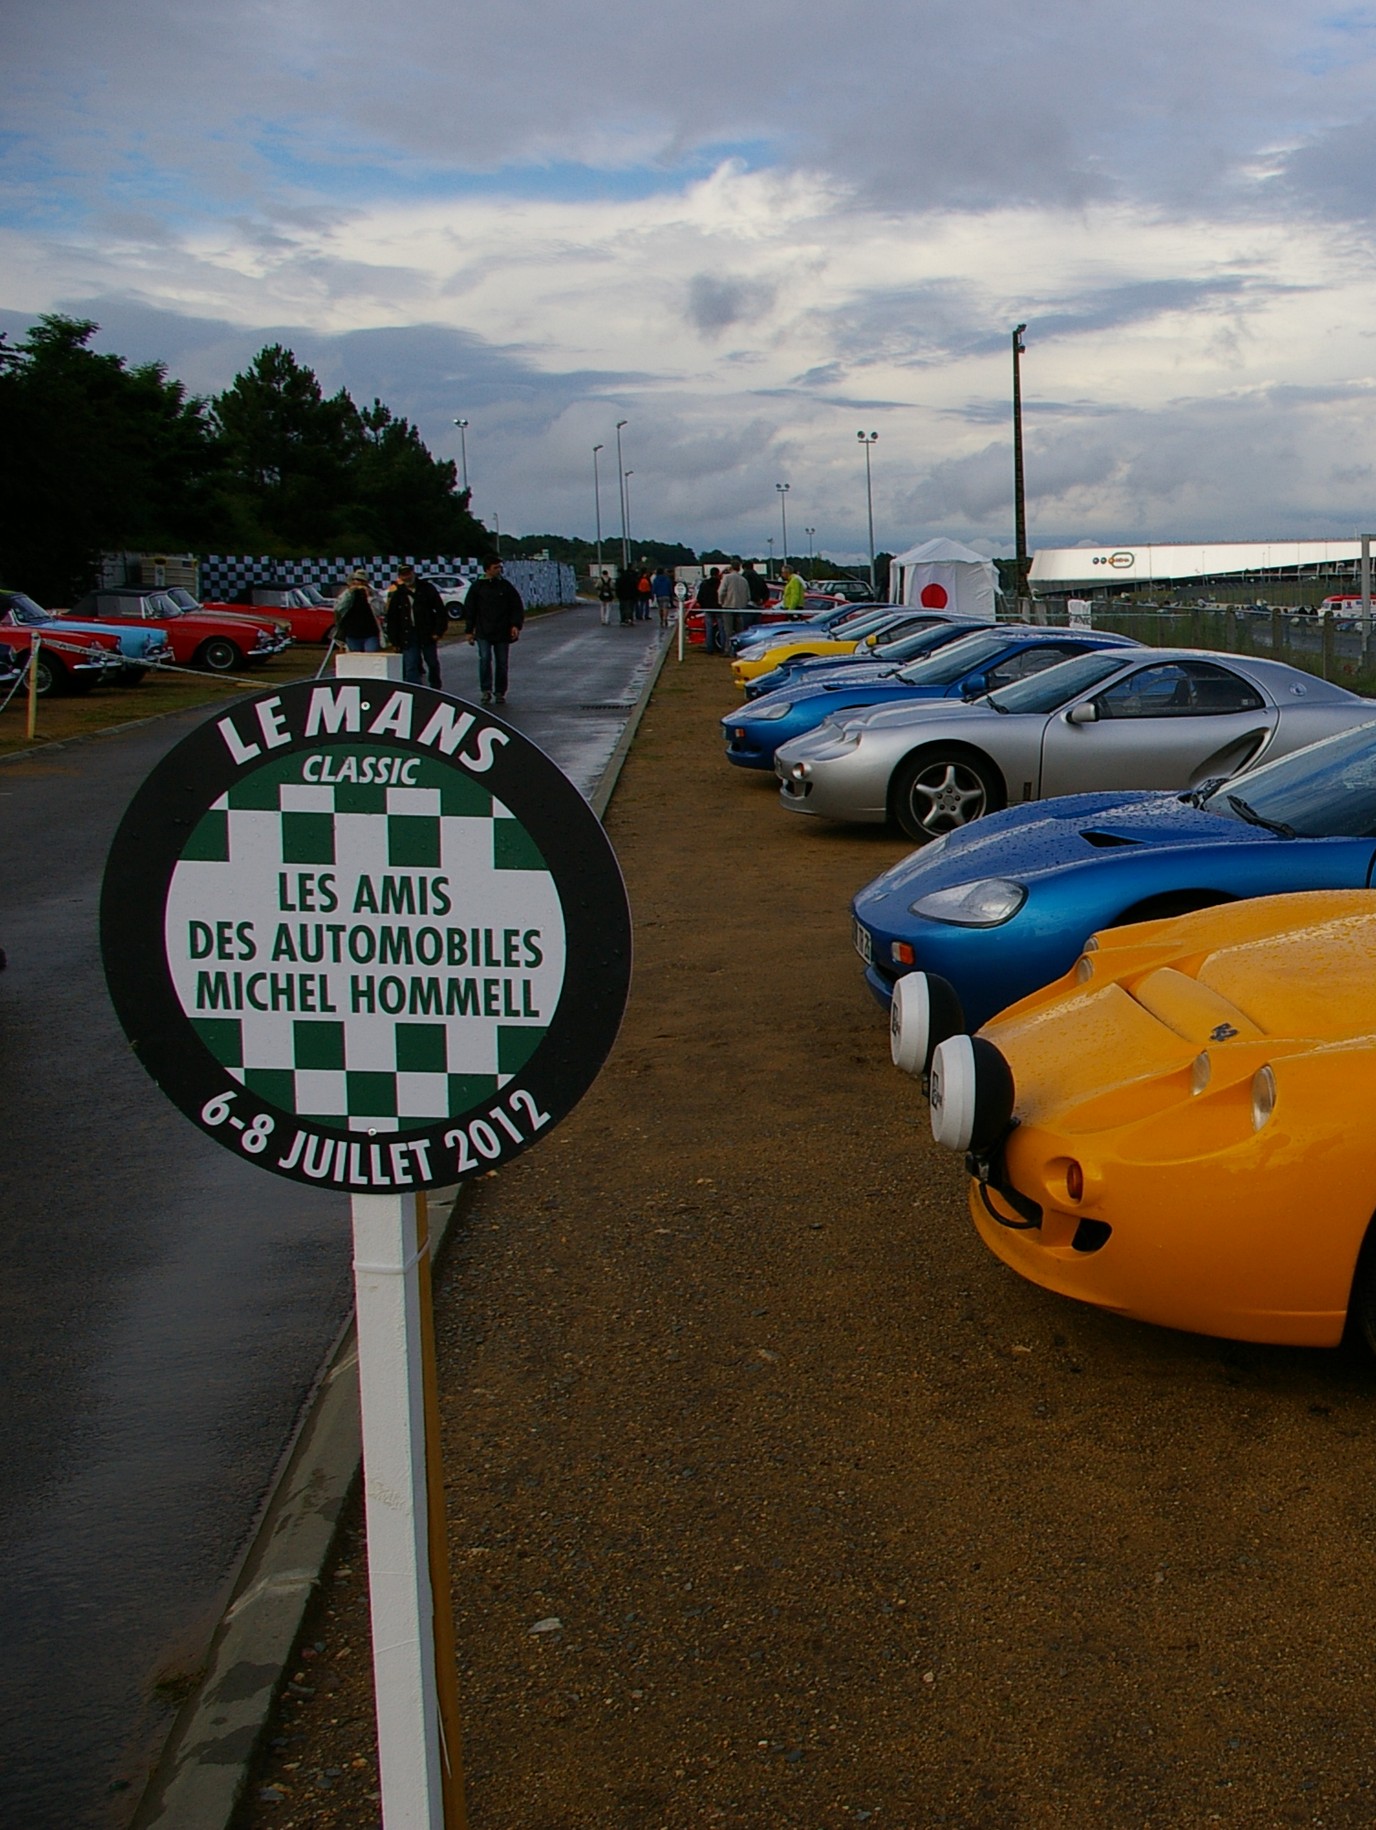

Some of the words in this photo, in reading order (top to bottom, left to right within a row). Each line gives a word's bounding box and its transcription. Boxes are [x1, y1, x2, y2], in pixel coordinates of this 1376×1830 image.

[217, 696, 292, 765] LE
[304, 685, 510, 773] MANS
[302, 755, 421, 784] CLASSIC
[278, 871, 339, 913] LES
[352, 874, 452, 917] AMIS
[188, 919, 257, 961] DES
[270, 922, 545, 969] AUTOMOBILES
[195, 970, 338, 1013] MICHEL
[350, 974, 541, 1018] HOMMELL
[200, 1090, 275, 1154] 6-8
[277, 1129, 434, 1186] JUILLET
[443, 1088, 551, 1173] 2012
